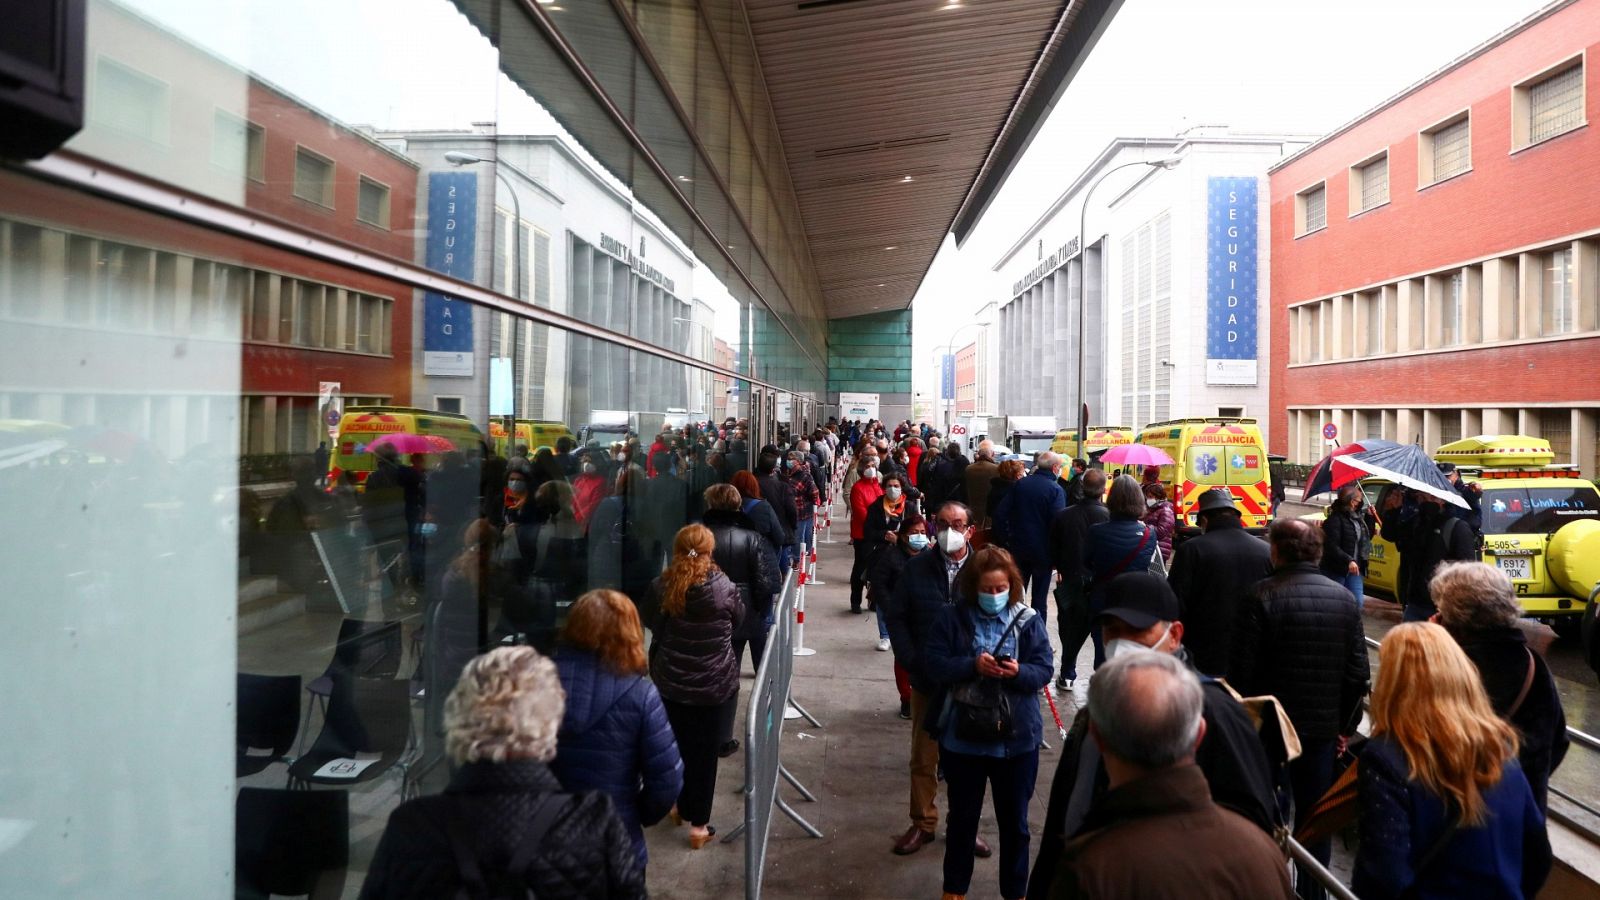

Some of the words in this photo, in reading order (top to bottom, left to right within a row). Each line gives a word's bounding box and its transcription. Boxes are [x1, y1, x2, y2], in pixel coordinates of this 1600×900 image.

[1228, 191, 1238, 343] SEGURIDAD
[1192, 435, 1256, 444] AMBULANCIA
[1503, 559, 1526, 568] 6912
